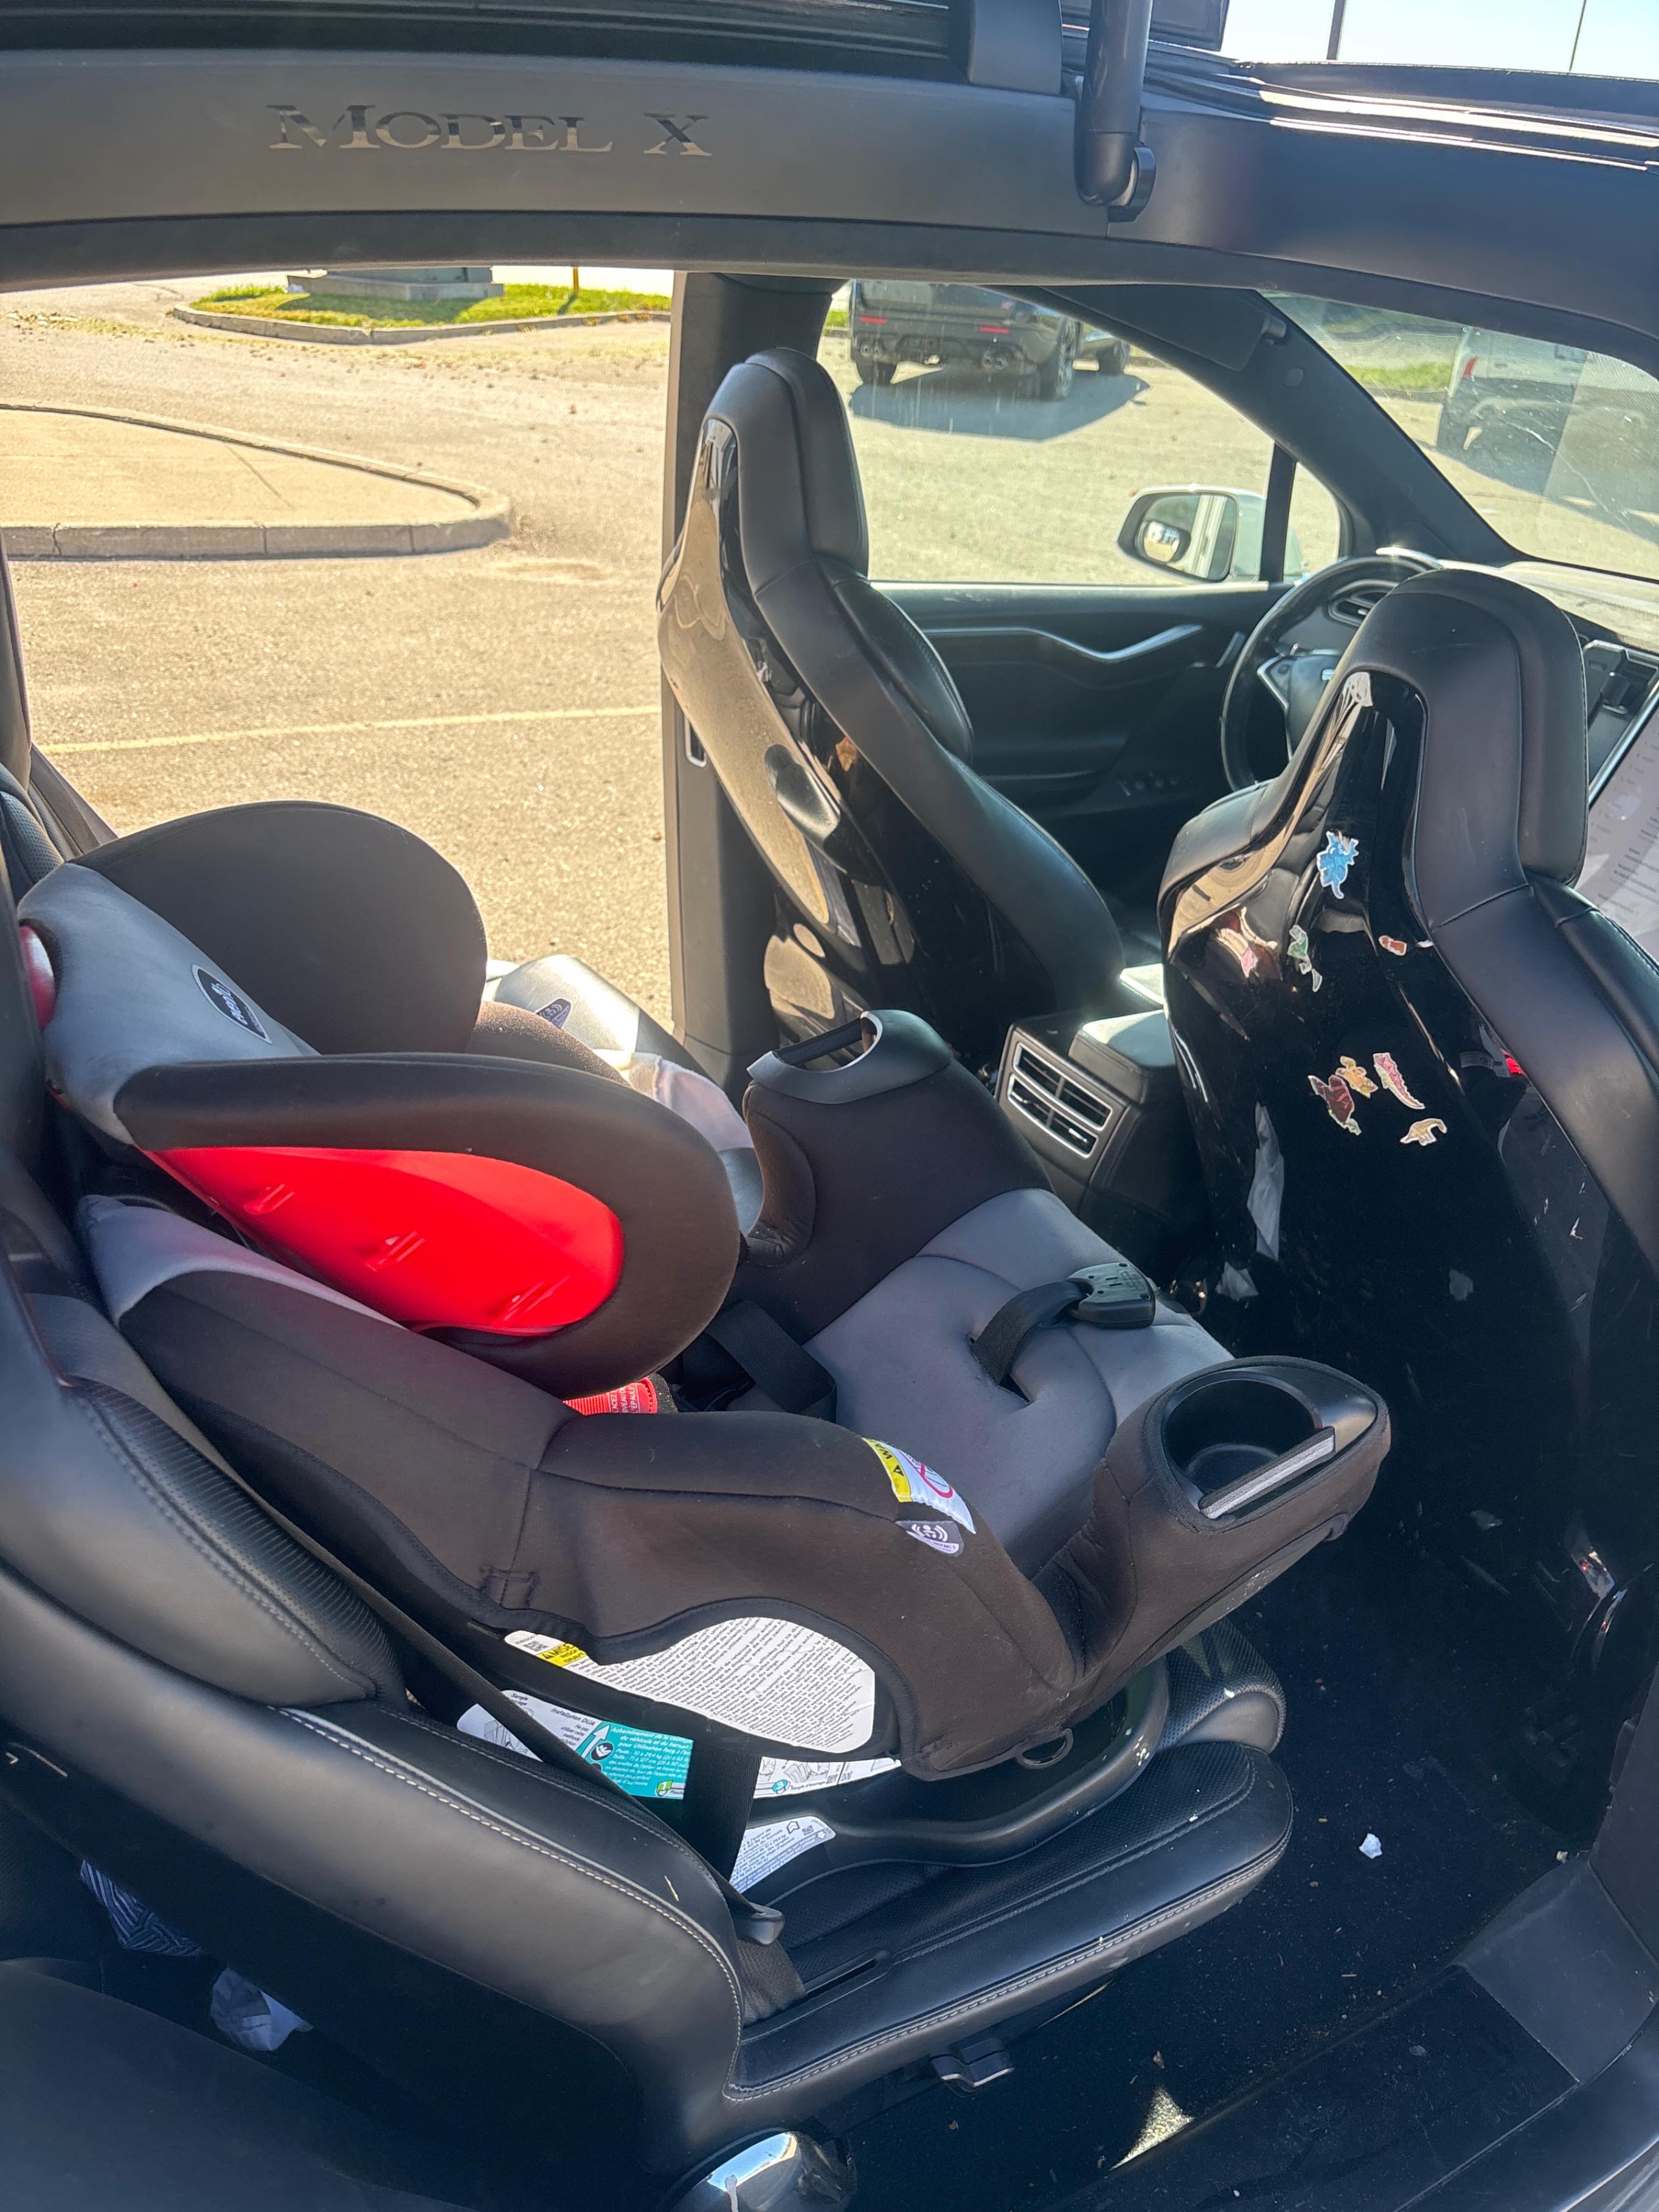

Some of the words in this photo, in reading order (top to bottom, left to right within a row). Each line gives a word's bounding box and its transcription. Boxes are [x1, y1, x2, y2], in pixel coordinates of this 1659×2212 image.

[267, 105, 612, 153] MODEL
[643, 112, 713, 157] X
[551, 1707, 581, 1721] Installation
[581, 1718, 595, 1726] DUA
